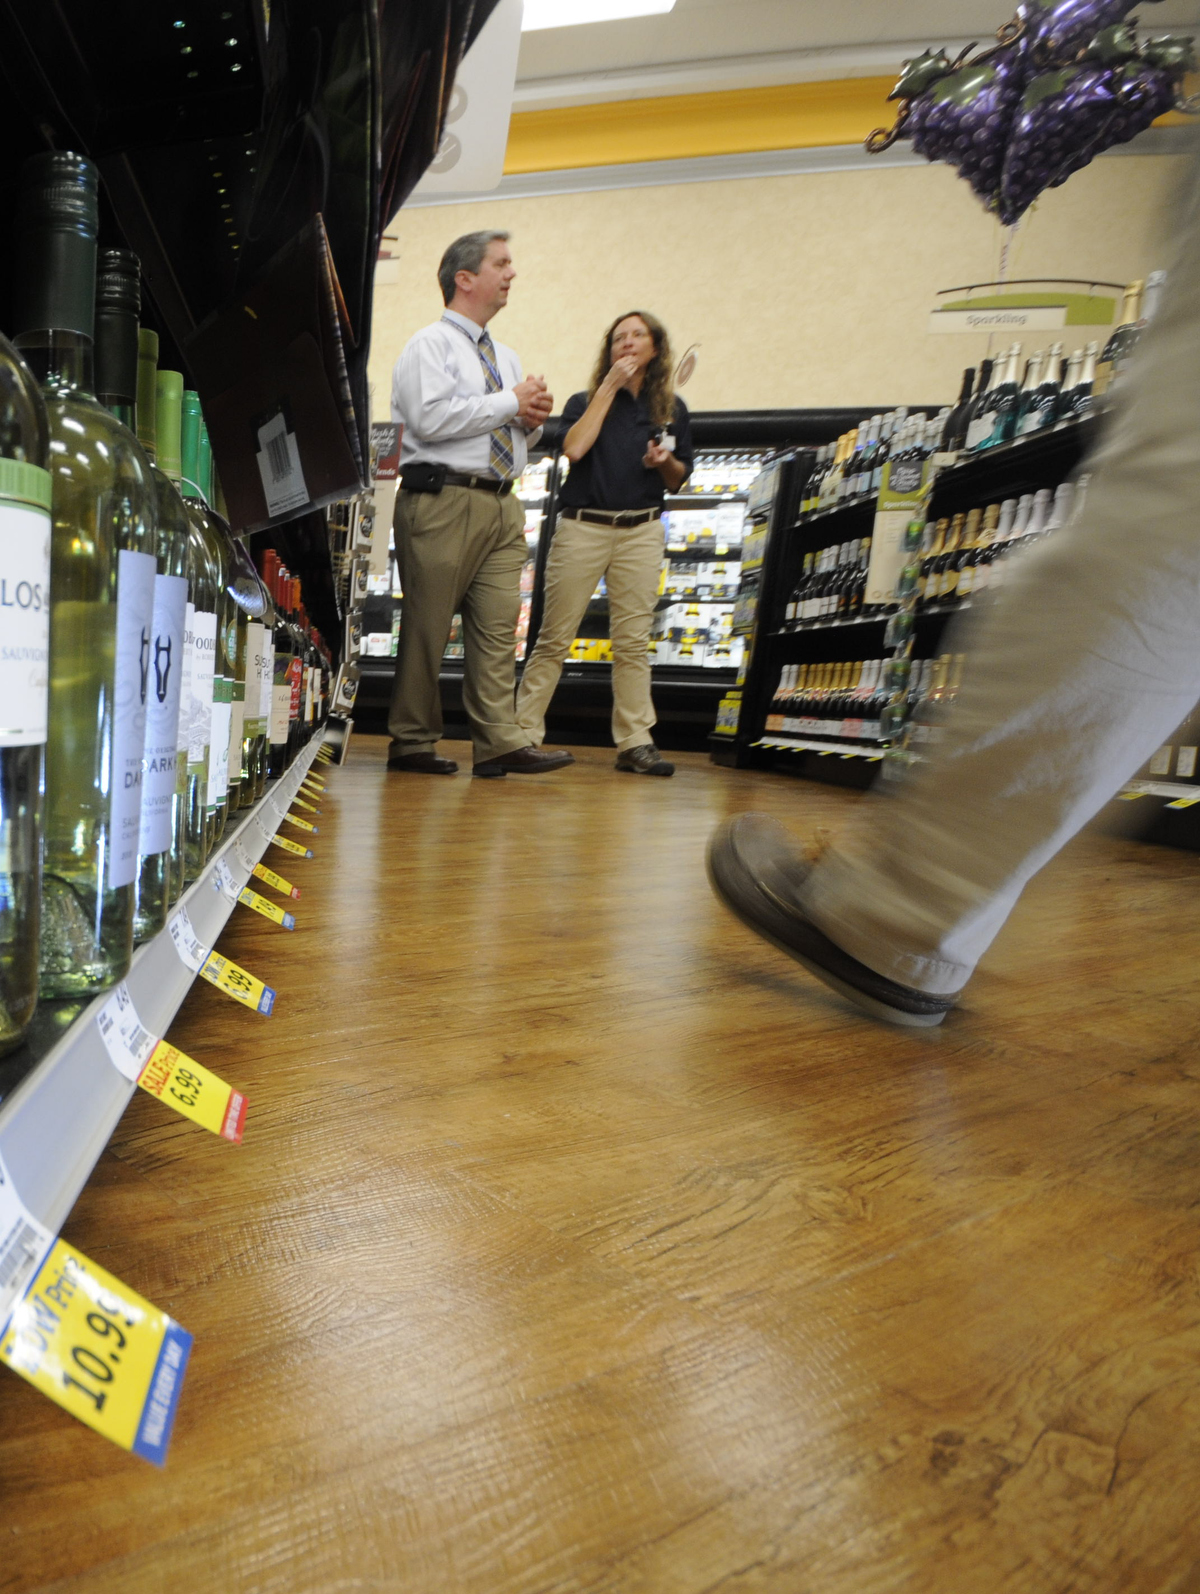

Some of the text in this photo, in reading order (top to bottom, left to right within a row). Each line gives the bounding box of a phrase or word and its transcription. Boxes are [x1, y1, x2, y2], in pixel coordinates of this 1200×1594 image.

[965, 313, 1028, 328] Sparkling
[376, 468, 397, 476] lends
[223, 969, 253, 1000] 6.99
[142, 1046, 181, 1097] SALE Price
[169, 1067, 203, 1107] 6.99
[163, 1338, 184, 1369] DAY
[153, 1368, 178, 1402] EVERY
